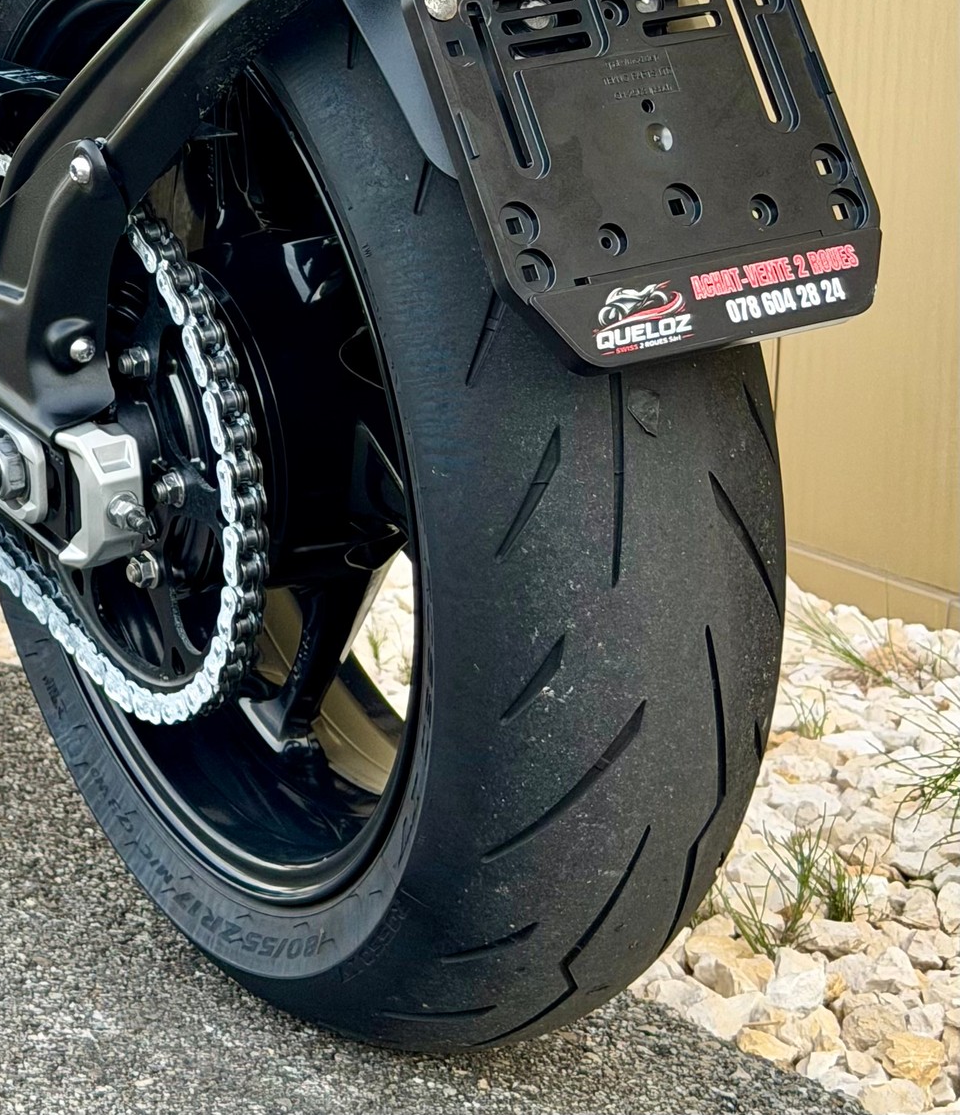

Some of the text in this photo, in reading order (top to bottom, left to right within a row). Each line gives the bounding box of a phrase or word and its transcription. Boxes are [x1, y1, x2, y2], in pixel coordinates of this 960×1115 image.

[690, 244, 859, 301] ACHAT-VENTE 2 ROUES
[725, 277, 846, 323] 078 604 28 24
[596, 313, 693, 350] QUELOZ
[615, 343, 639, 354] SWISS
[644, 336, 669, 348] ROUES
